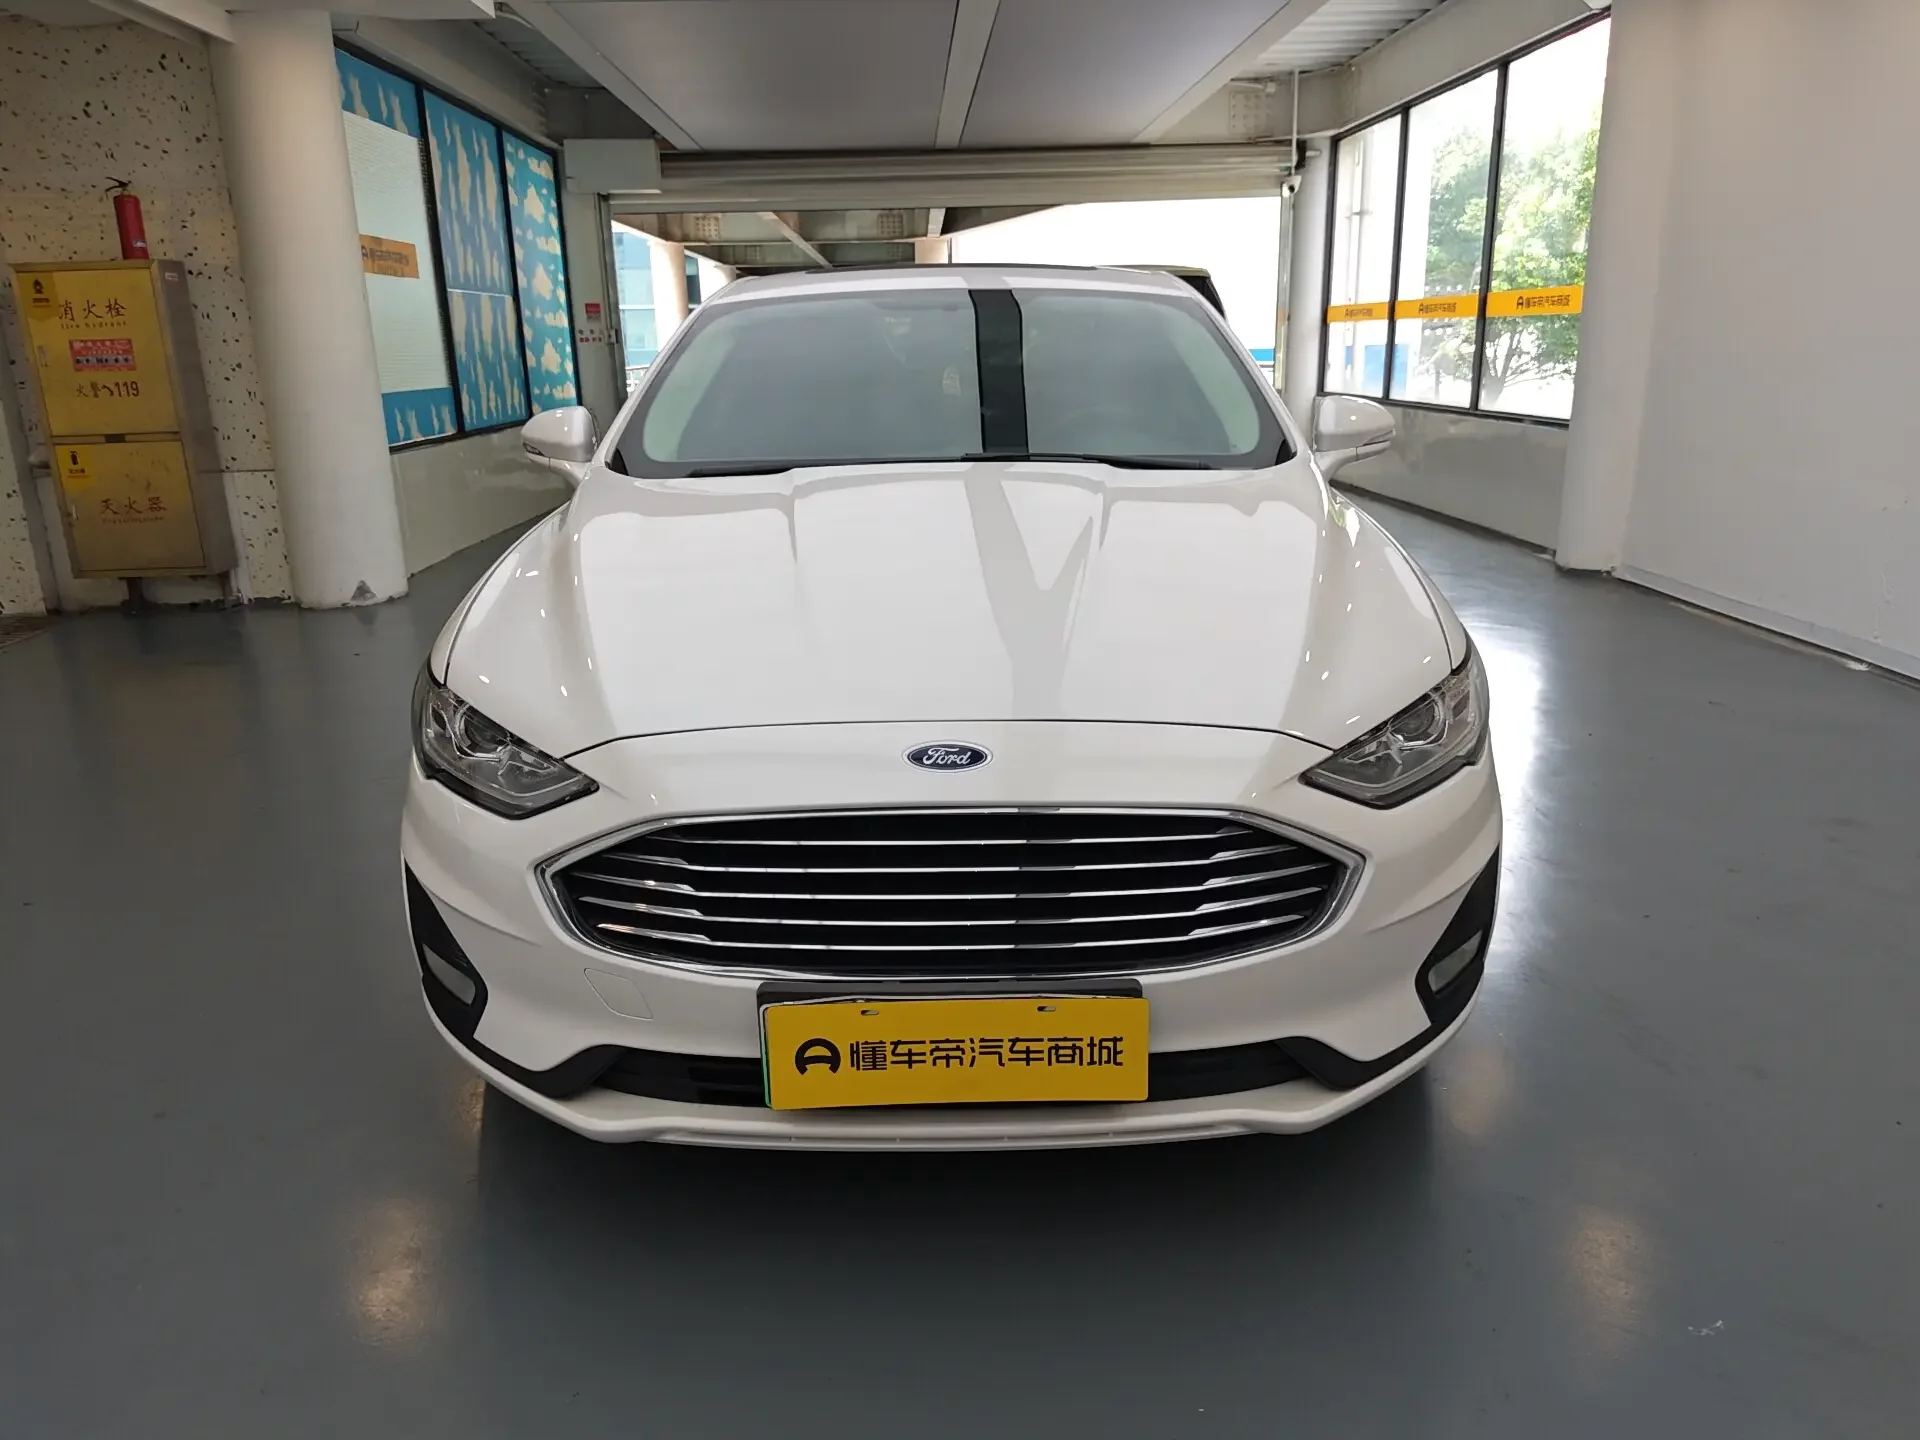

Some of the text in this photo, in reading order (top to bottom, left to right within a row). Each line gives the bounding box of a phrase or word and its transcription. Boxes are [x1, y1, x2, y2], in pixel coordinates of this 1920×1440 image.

[59, 298, 127, 322] 消火栓
[115, 380, 140, 398] 119
[101, 496, 168, 515] 灭火器
[922, 747, 972, 765] Ford
[849, 1036, 1124, 1072] 懂车帝汽车商城
